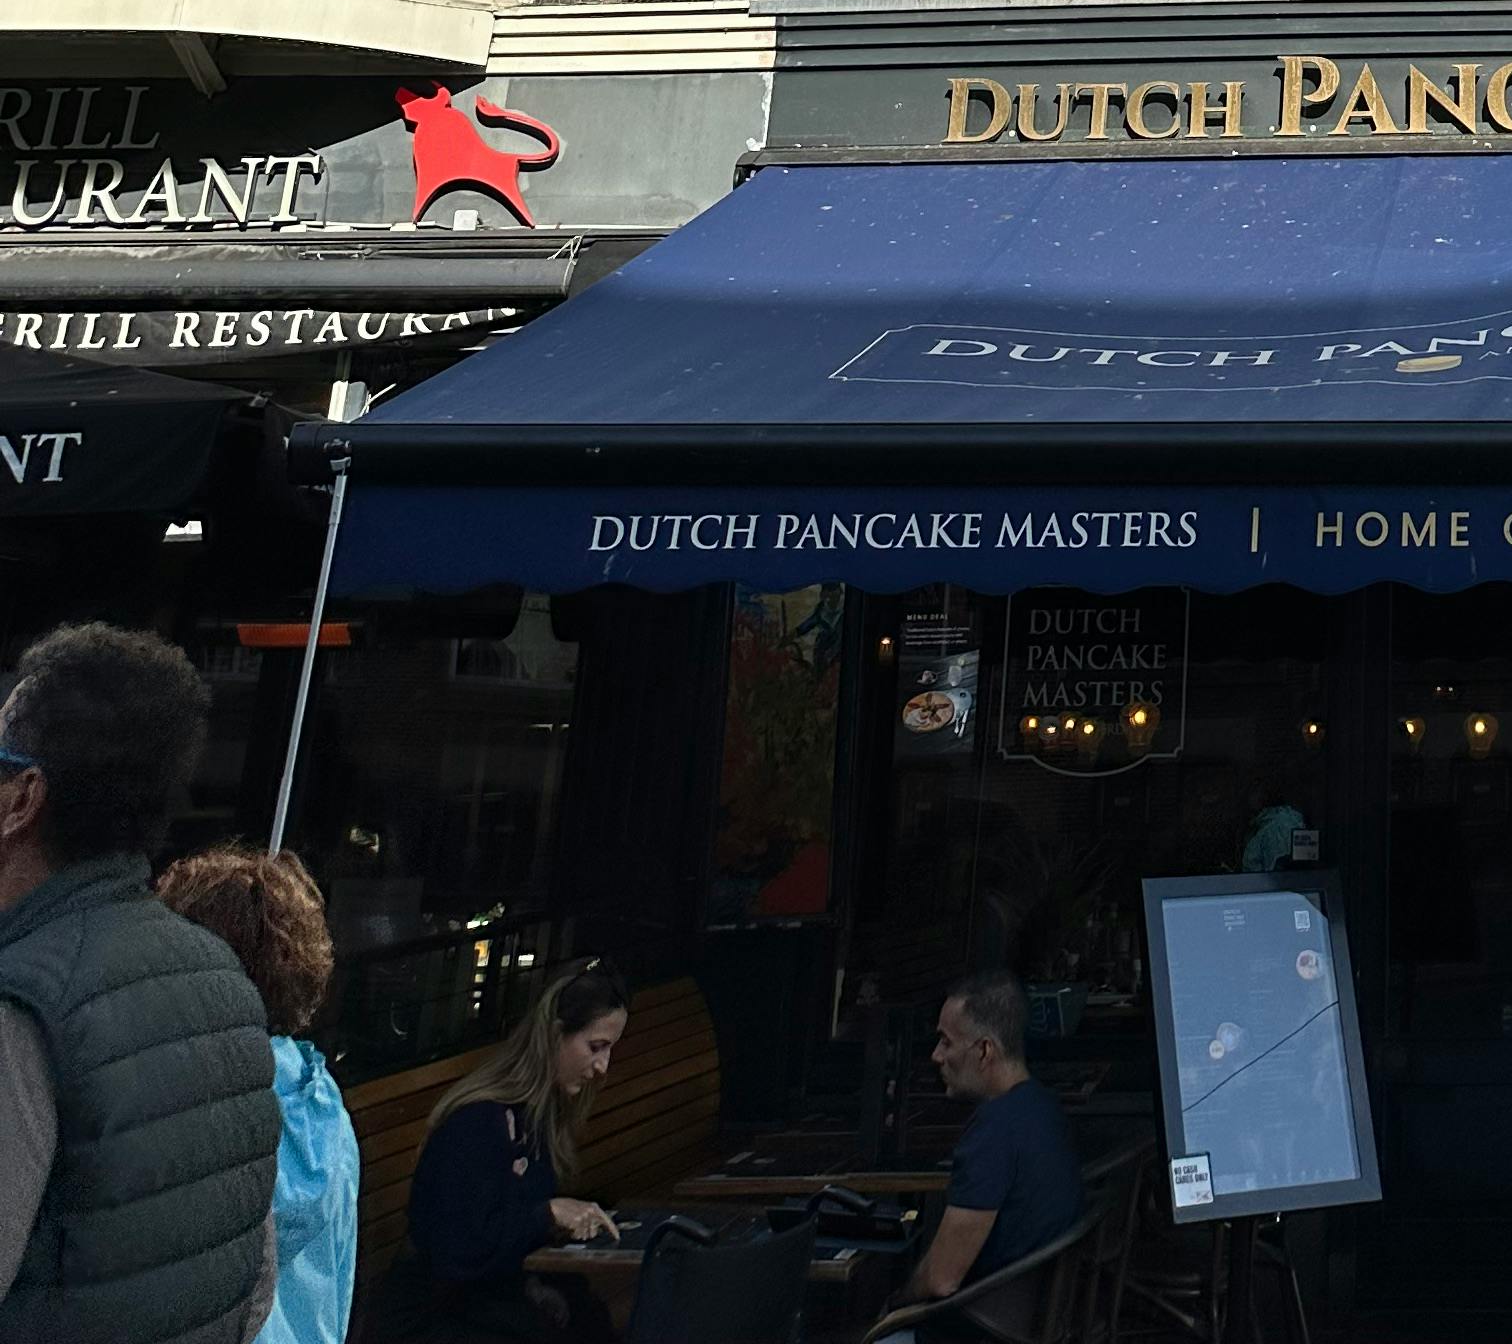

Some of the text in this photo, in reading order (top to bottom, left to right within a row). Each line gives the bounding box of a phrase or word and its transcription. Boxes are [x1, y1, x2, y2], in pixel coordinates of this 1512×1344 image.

[942, 77, 1247, 143] DUTCH
[926, 338, 1278, 368] DUTCH
[589, 511, 1198, 551] DUTCH PANCAKE MASTERS
[1316, 512, 1470, 547] HOME
[1029, 608, 1142, 635] DUTCH
[1026, 643, 1168, 672] PANCAKE
[1022, 680, 1165, 707] MASTERS
